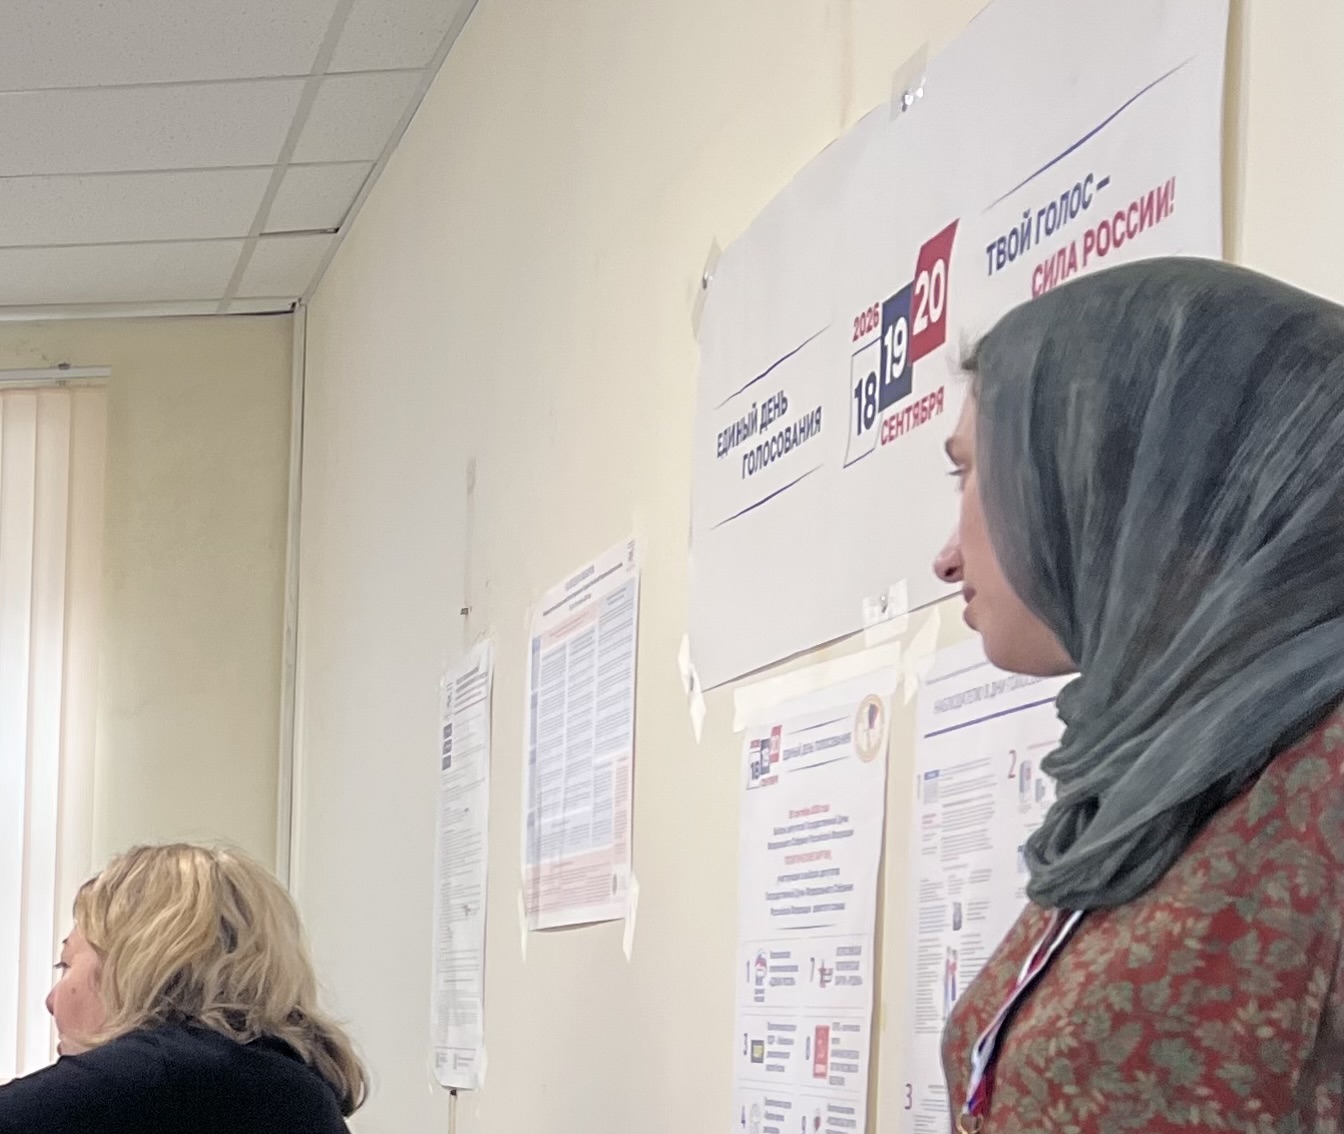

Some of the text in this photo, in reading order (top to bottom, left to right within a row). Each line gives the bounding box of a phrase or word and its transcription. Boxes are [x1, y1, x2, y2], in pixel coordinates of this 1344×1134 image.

[986, 208, 1032, 275] ТВОЙ
[1035, 173, 1093, 245] ГОЛОС
[1032, 176, 1176, 299] СИЛА РОССИИ!
[853, 302, 880, 342] 2026
[913, 259, 945, 335] 20
[883, 316, 908, 385] 19
[717, 390, 788, 458] ЕДИНЫЙ ДЕНЬ
[854, 371, 877, 436] 18
[881, 385, 945, 446] СЕНТЯБРЯ
[742, 406, 822, 480] ГОЛОСОВАНИЯ
[1008, 749, 1017, 779] 2
